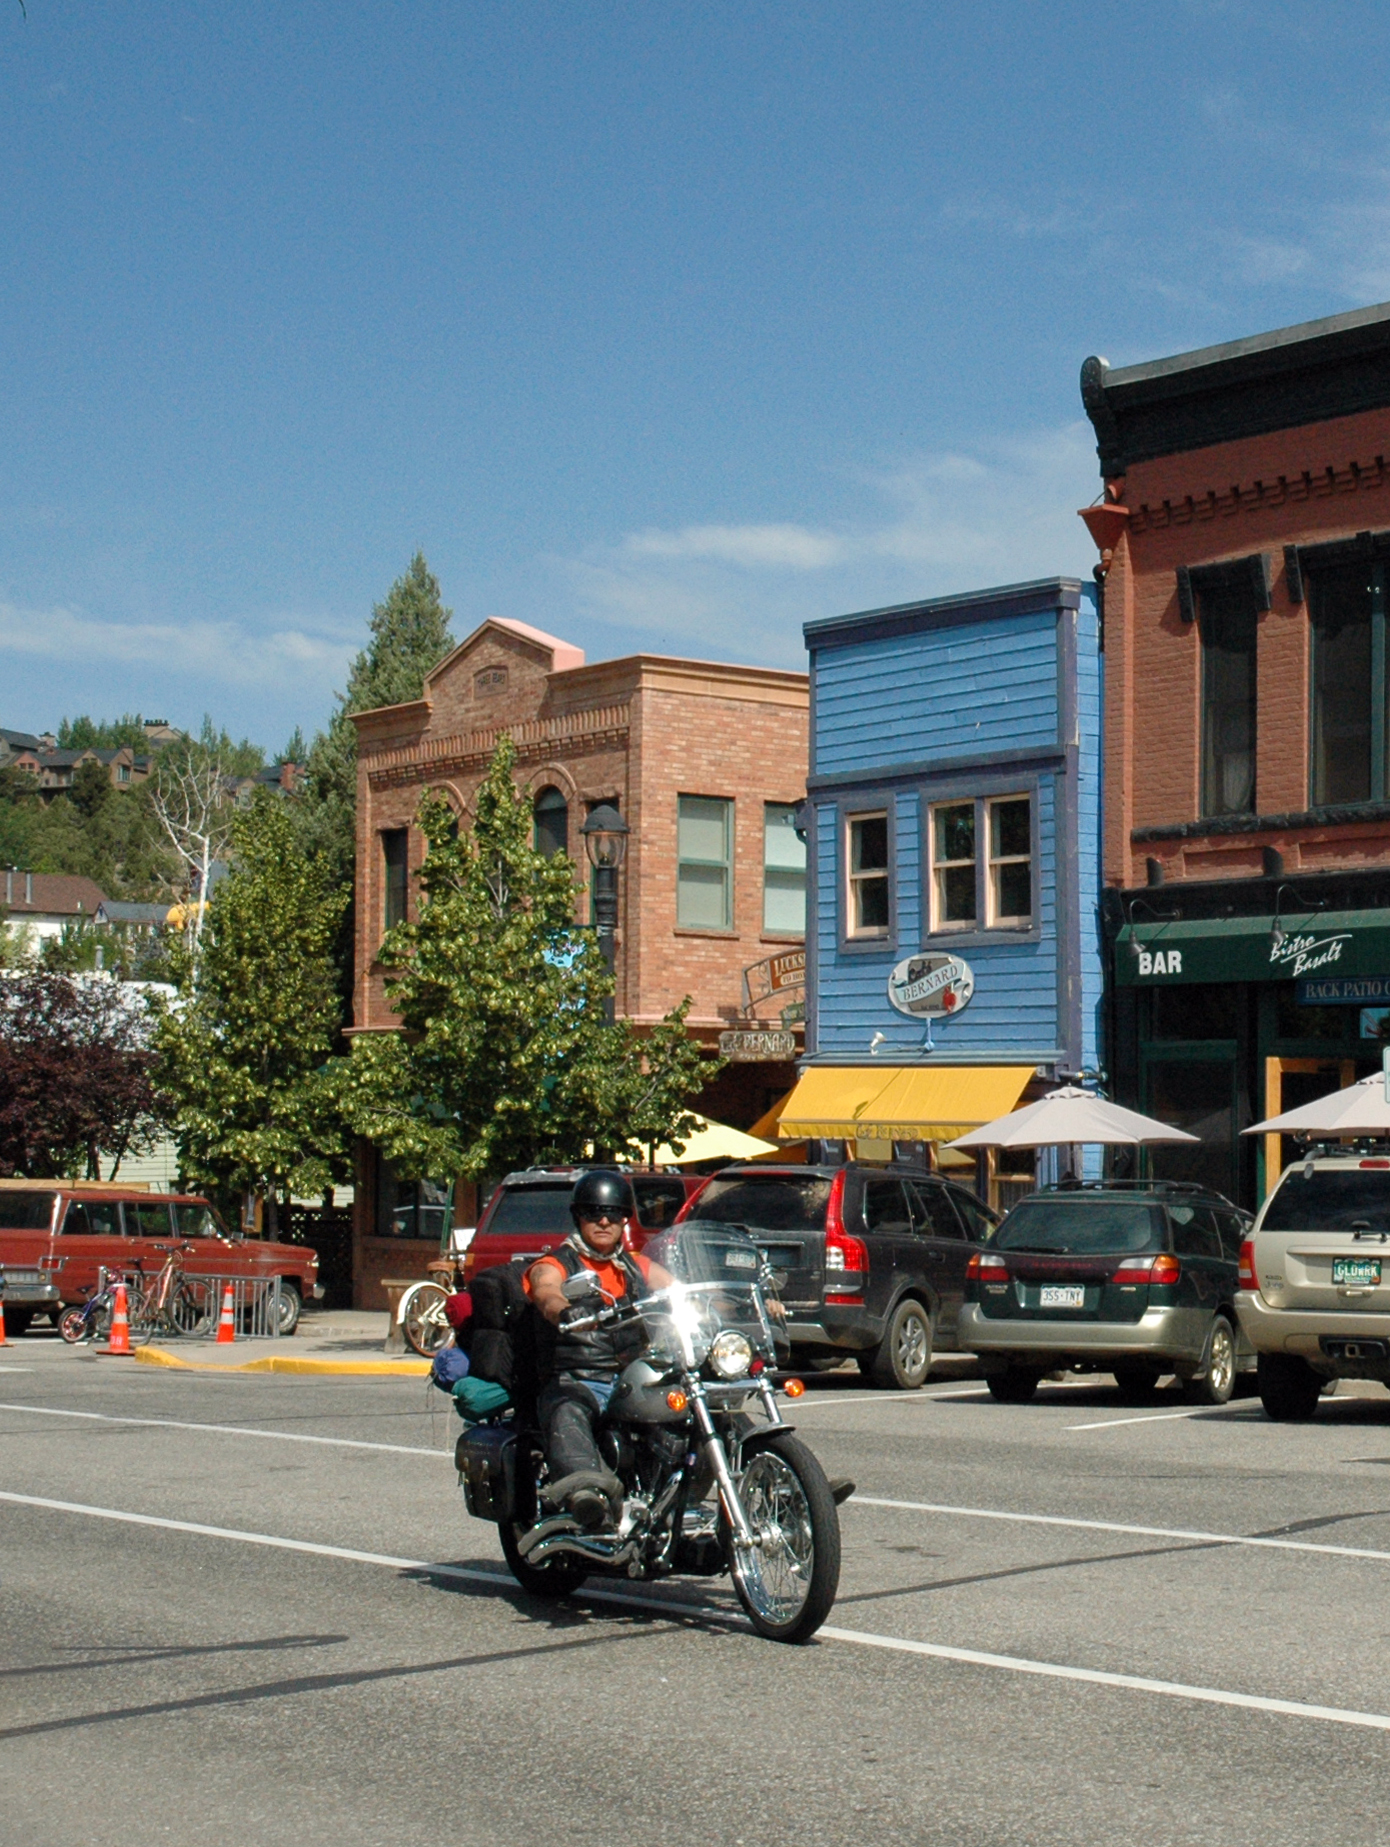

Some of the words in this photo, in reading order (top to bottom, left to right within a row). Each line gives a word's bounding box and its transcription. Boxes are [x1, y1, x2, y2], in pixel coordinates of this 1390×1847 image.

[1139, 950, 1182, 975] BAR
[1292, 940, 1343, 976] Basalt
[901, 965, 959, 1001] BERNARD
[1305, 982, 1339, 1000] BACK
[1343, 980, 1382, 998] PATIO
